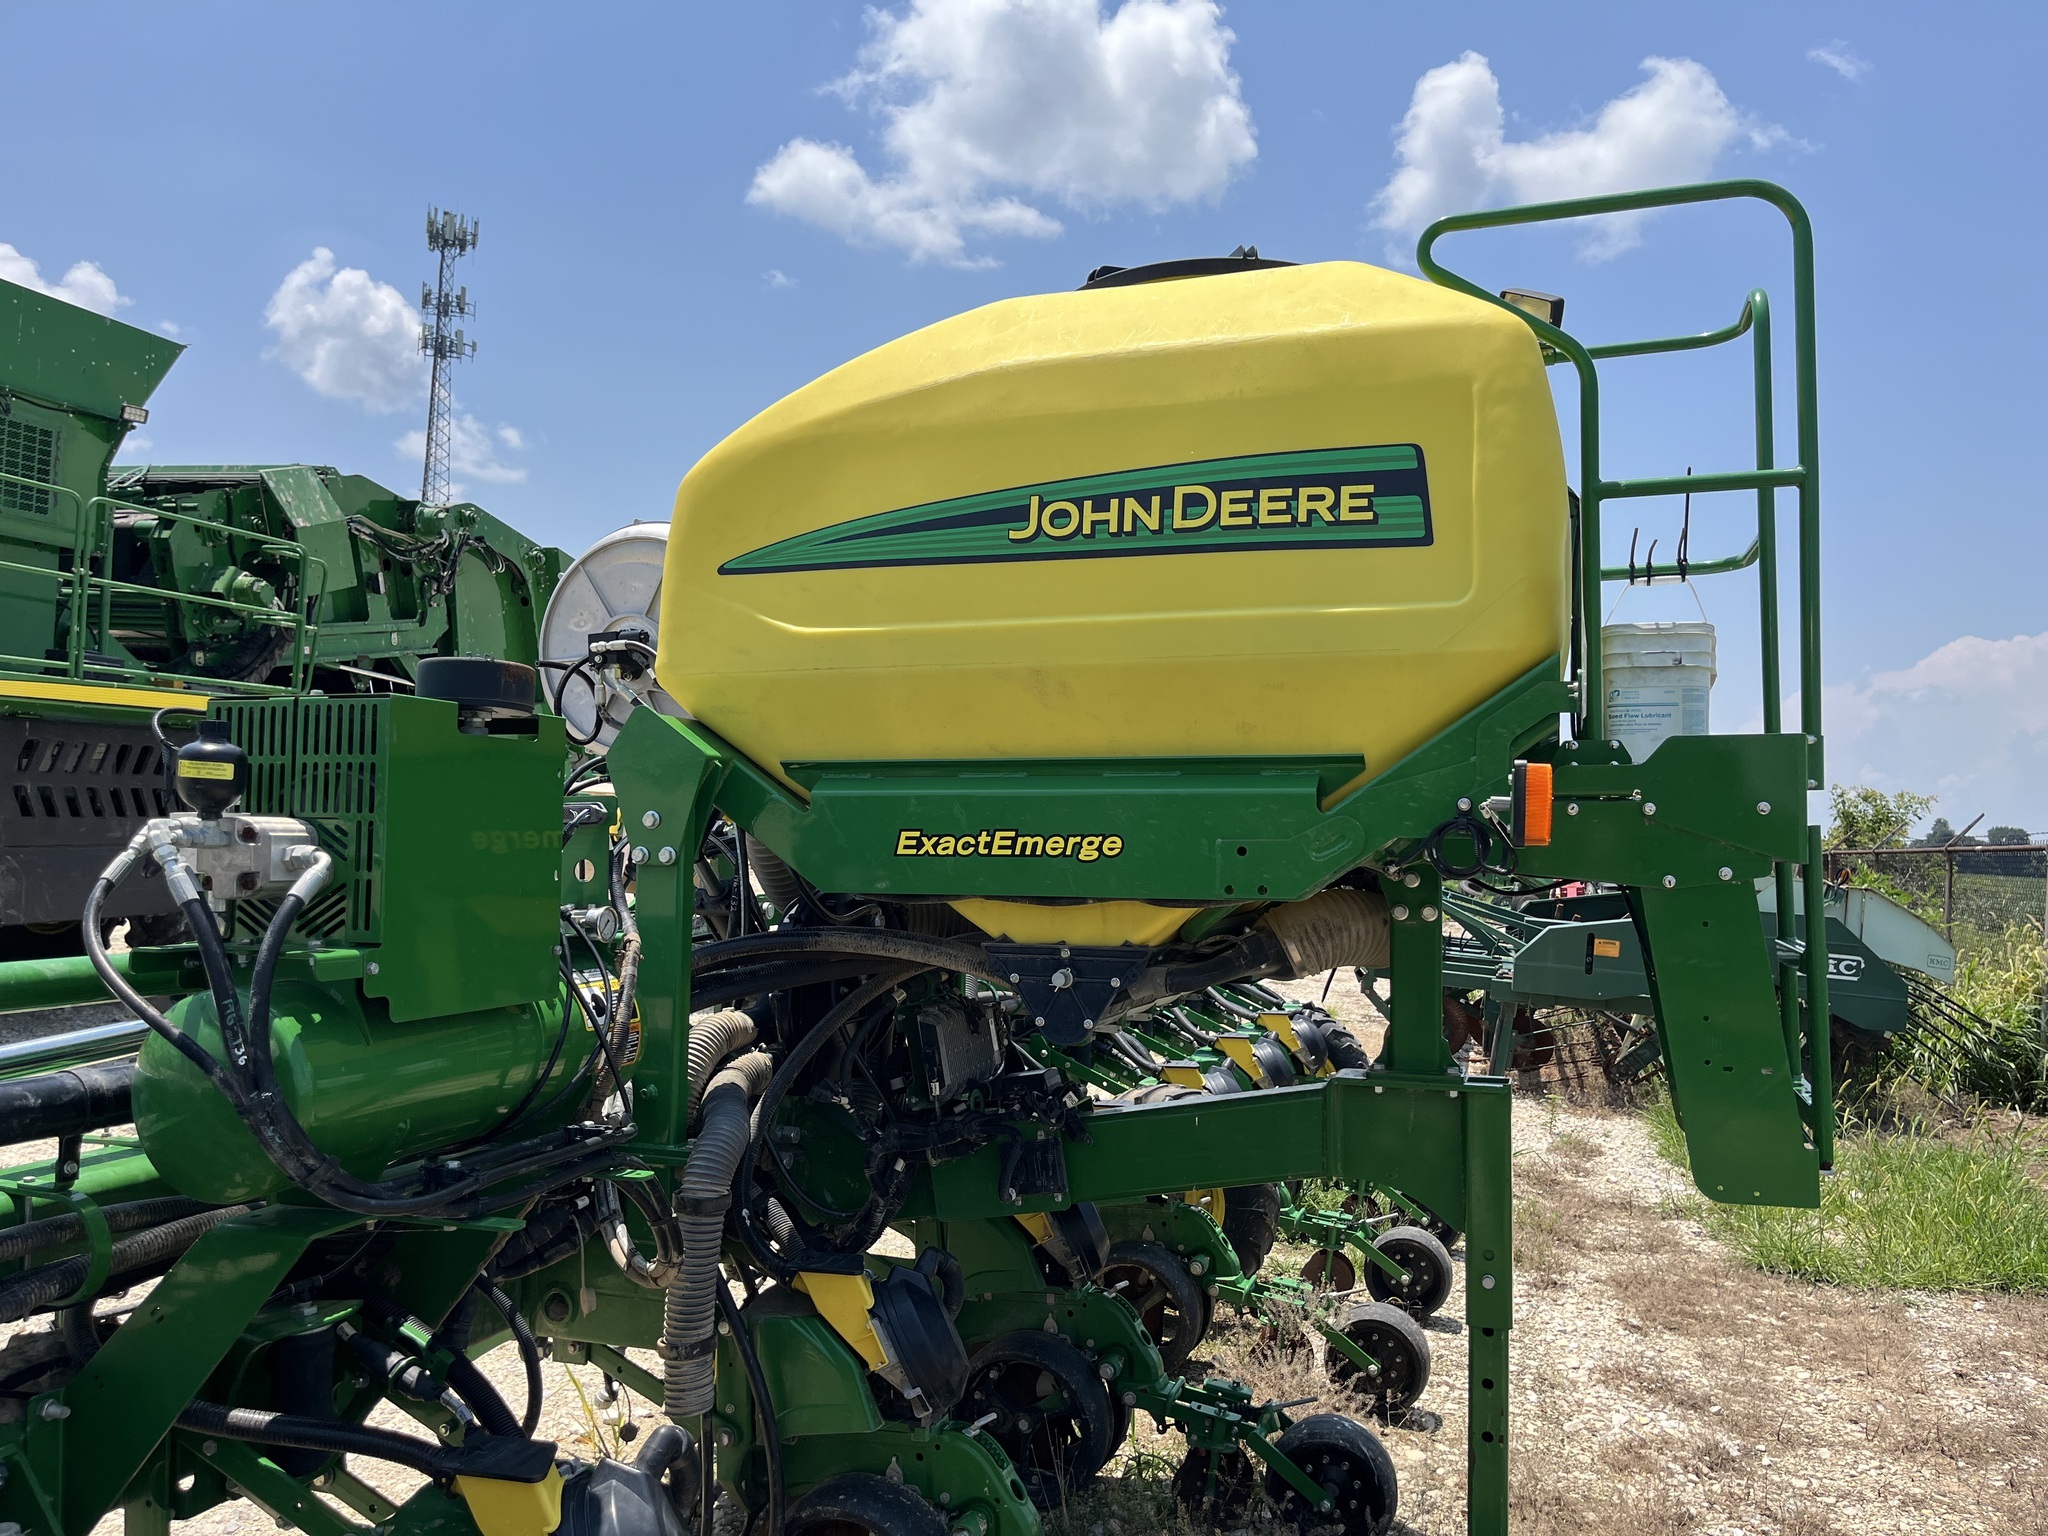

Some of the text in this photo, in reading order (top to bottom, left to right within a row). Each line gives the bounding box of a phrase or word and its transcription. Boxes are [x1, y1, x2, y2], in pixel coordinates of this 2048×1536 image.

[1008, 484, 1375, 541] JOHN DEERE
[895, 829, 1124, 862] ExactEmerge
